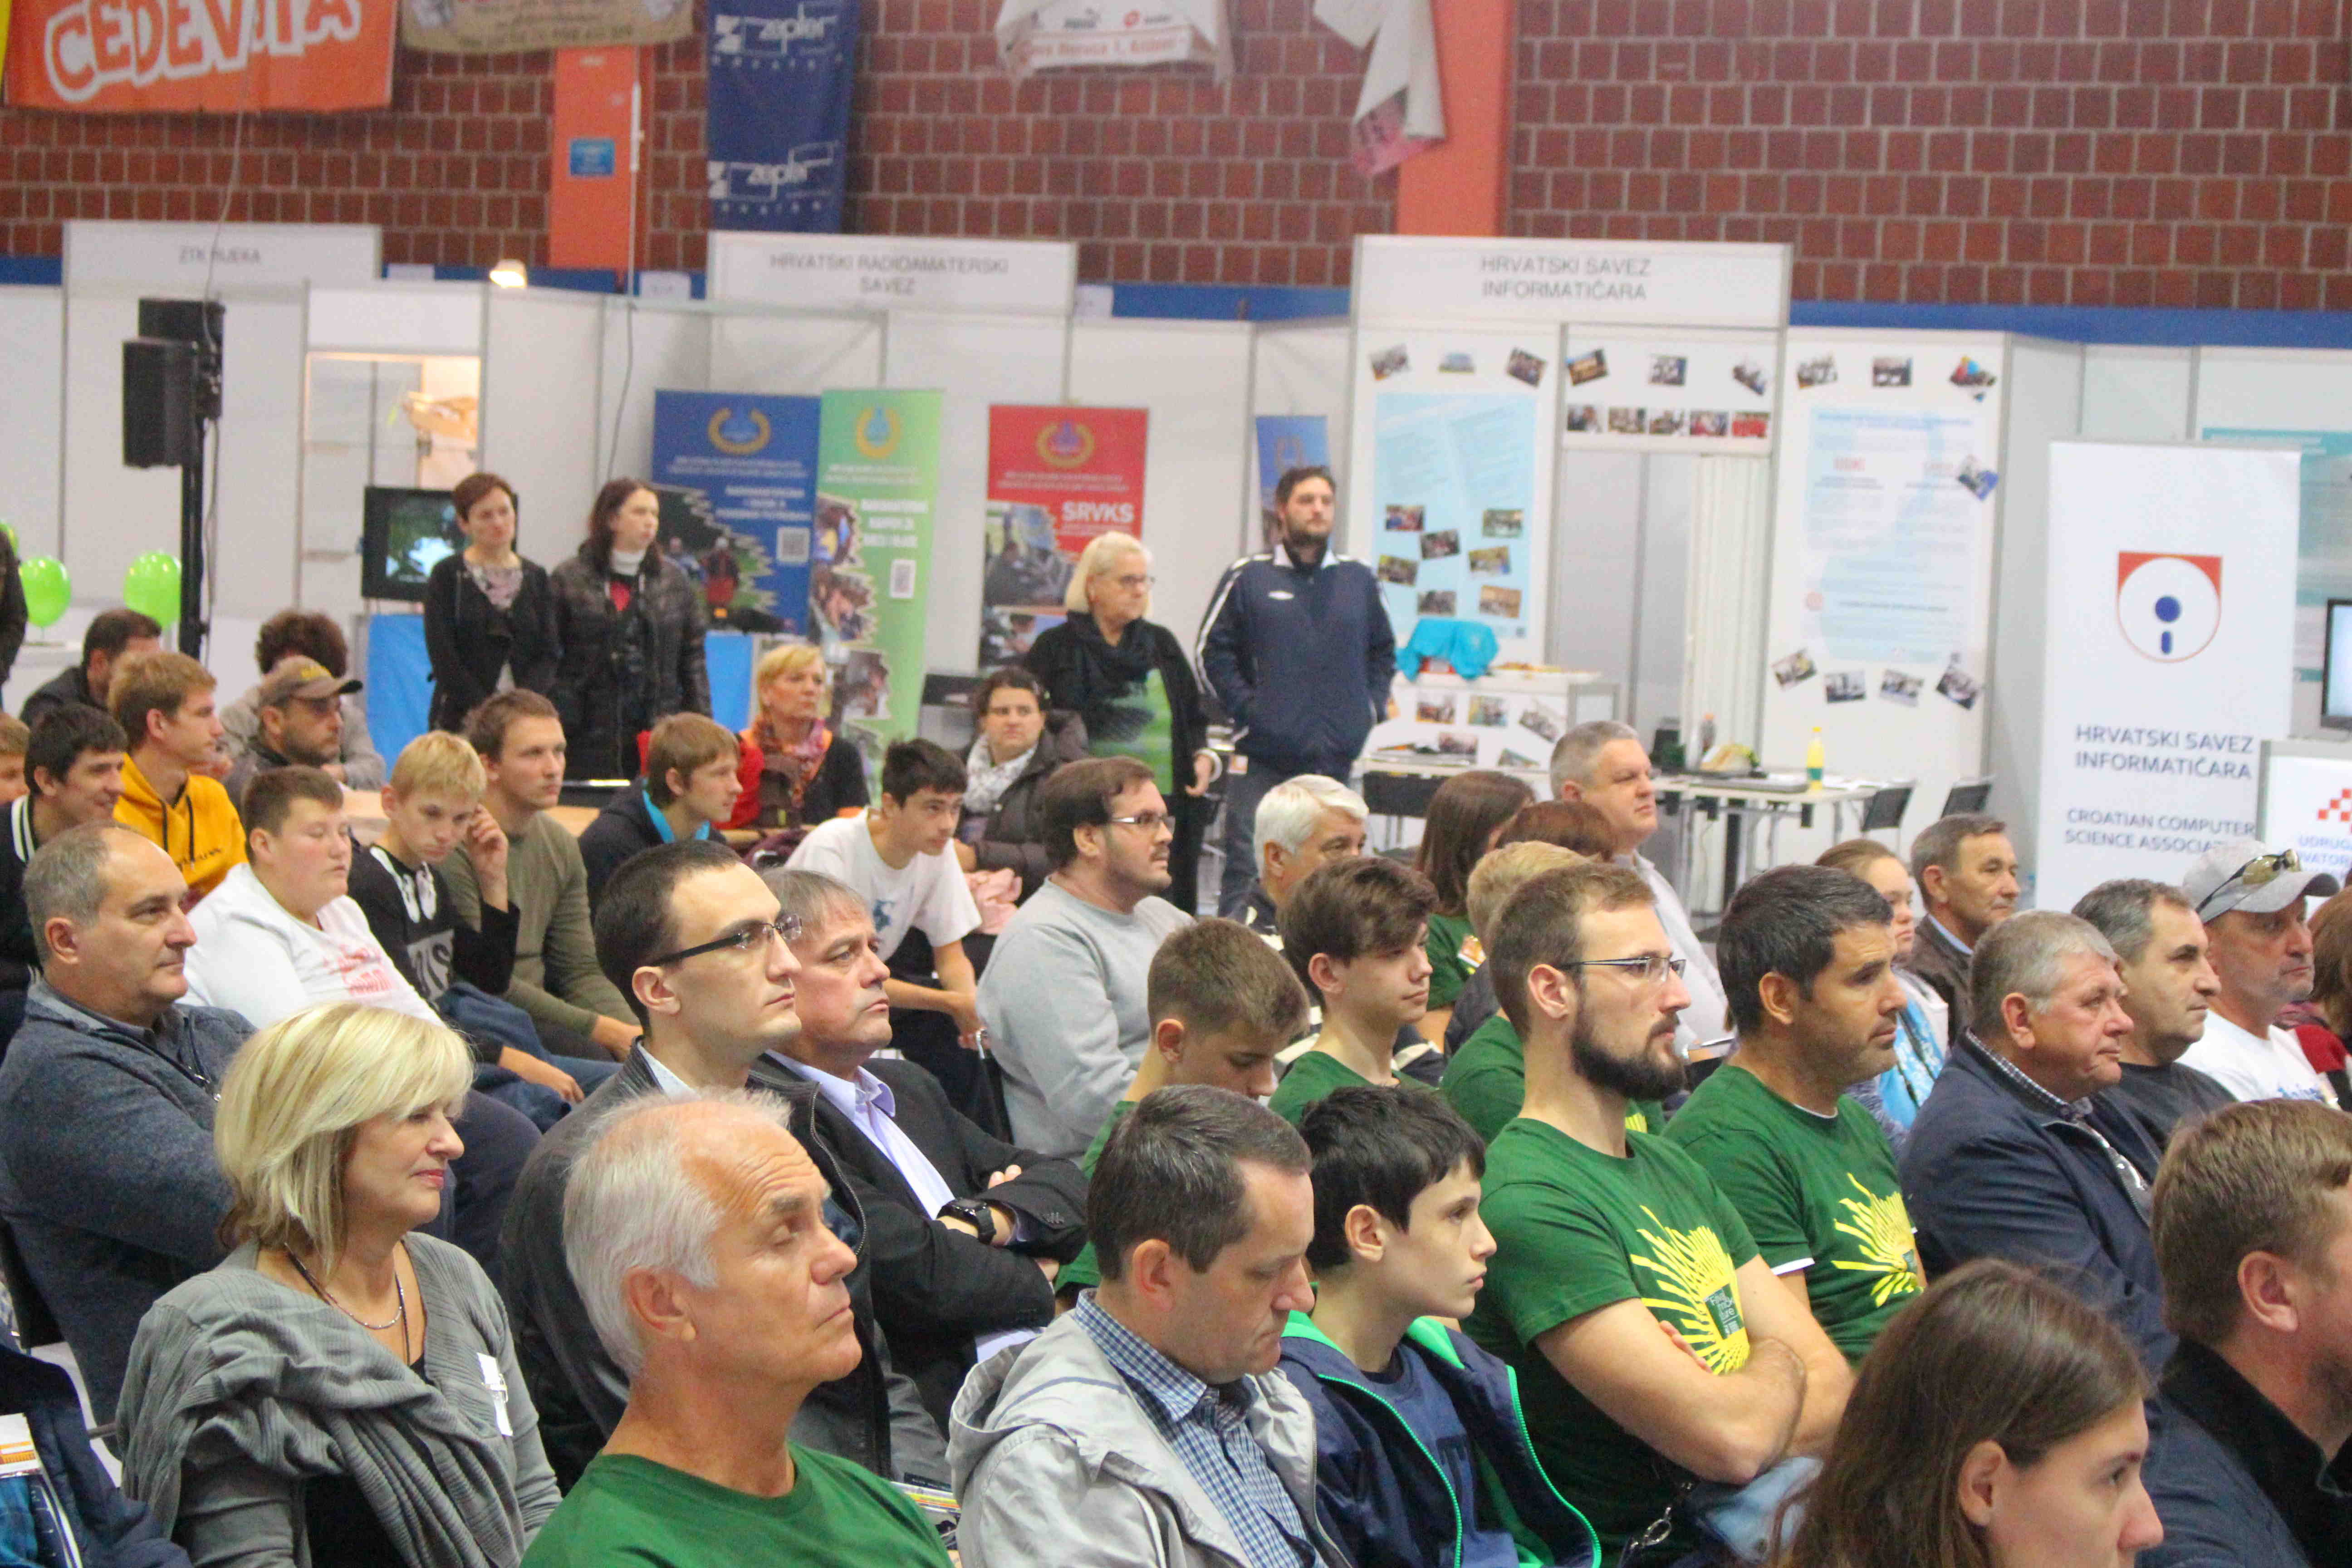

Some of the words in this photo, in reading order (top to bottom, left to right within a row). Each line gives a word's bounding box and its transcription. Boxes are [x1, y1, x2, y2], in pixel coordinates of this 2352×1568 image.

[770, 254, 853, 270] HRVATSKI
[857, 254, 1009, 274] RADIOAMATERSKI
[1480, 255, 1578, 274] HRVATSKI
[1586, 257, 1651, 277] SAVEZ
[859, 276, 915, 295] SAVEZ
[1482, 279, 1647, 300] INFORMATIČARA
[1062, 500, 1134, 523] SRVKS
[2075, 724, 2179, 748] HRVATSKI
[2185, 732, 2254, 754] SAVEZ
[2075, 750, 2253, 779] INFORMATIČARA
[2067, 807, 2154, 828] CROATIAN
[2158, 815, 2256, 837] COMPUTER
[2064, 828, 2136, 848] SCIENCE
[2139, 835, 2223, 853] ASSOCIA
[2298, 835, 2352, 851] UDRUG
